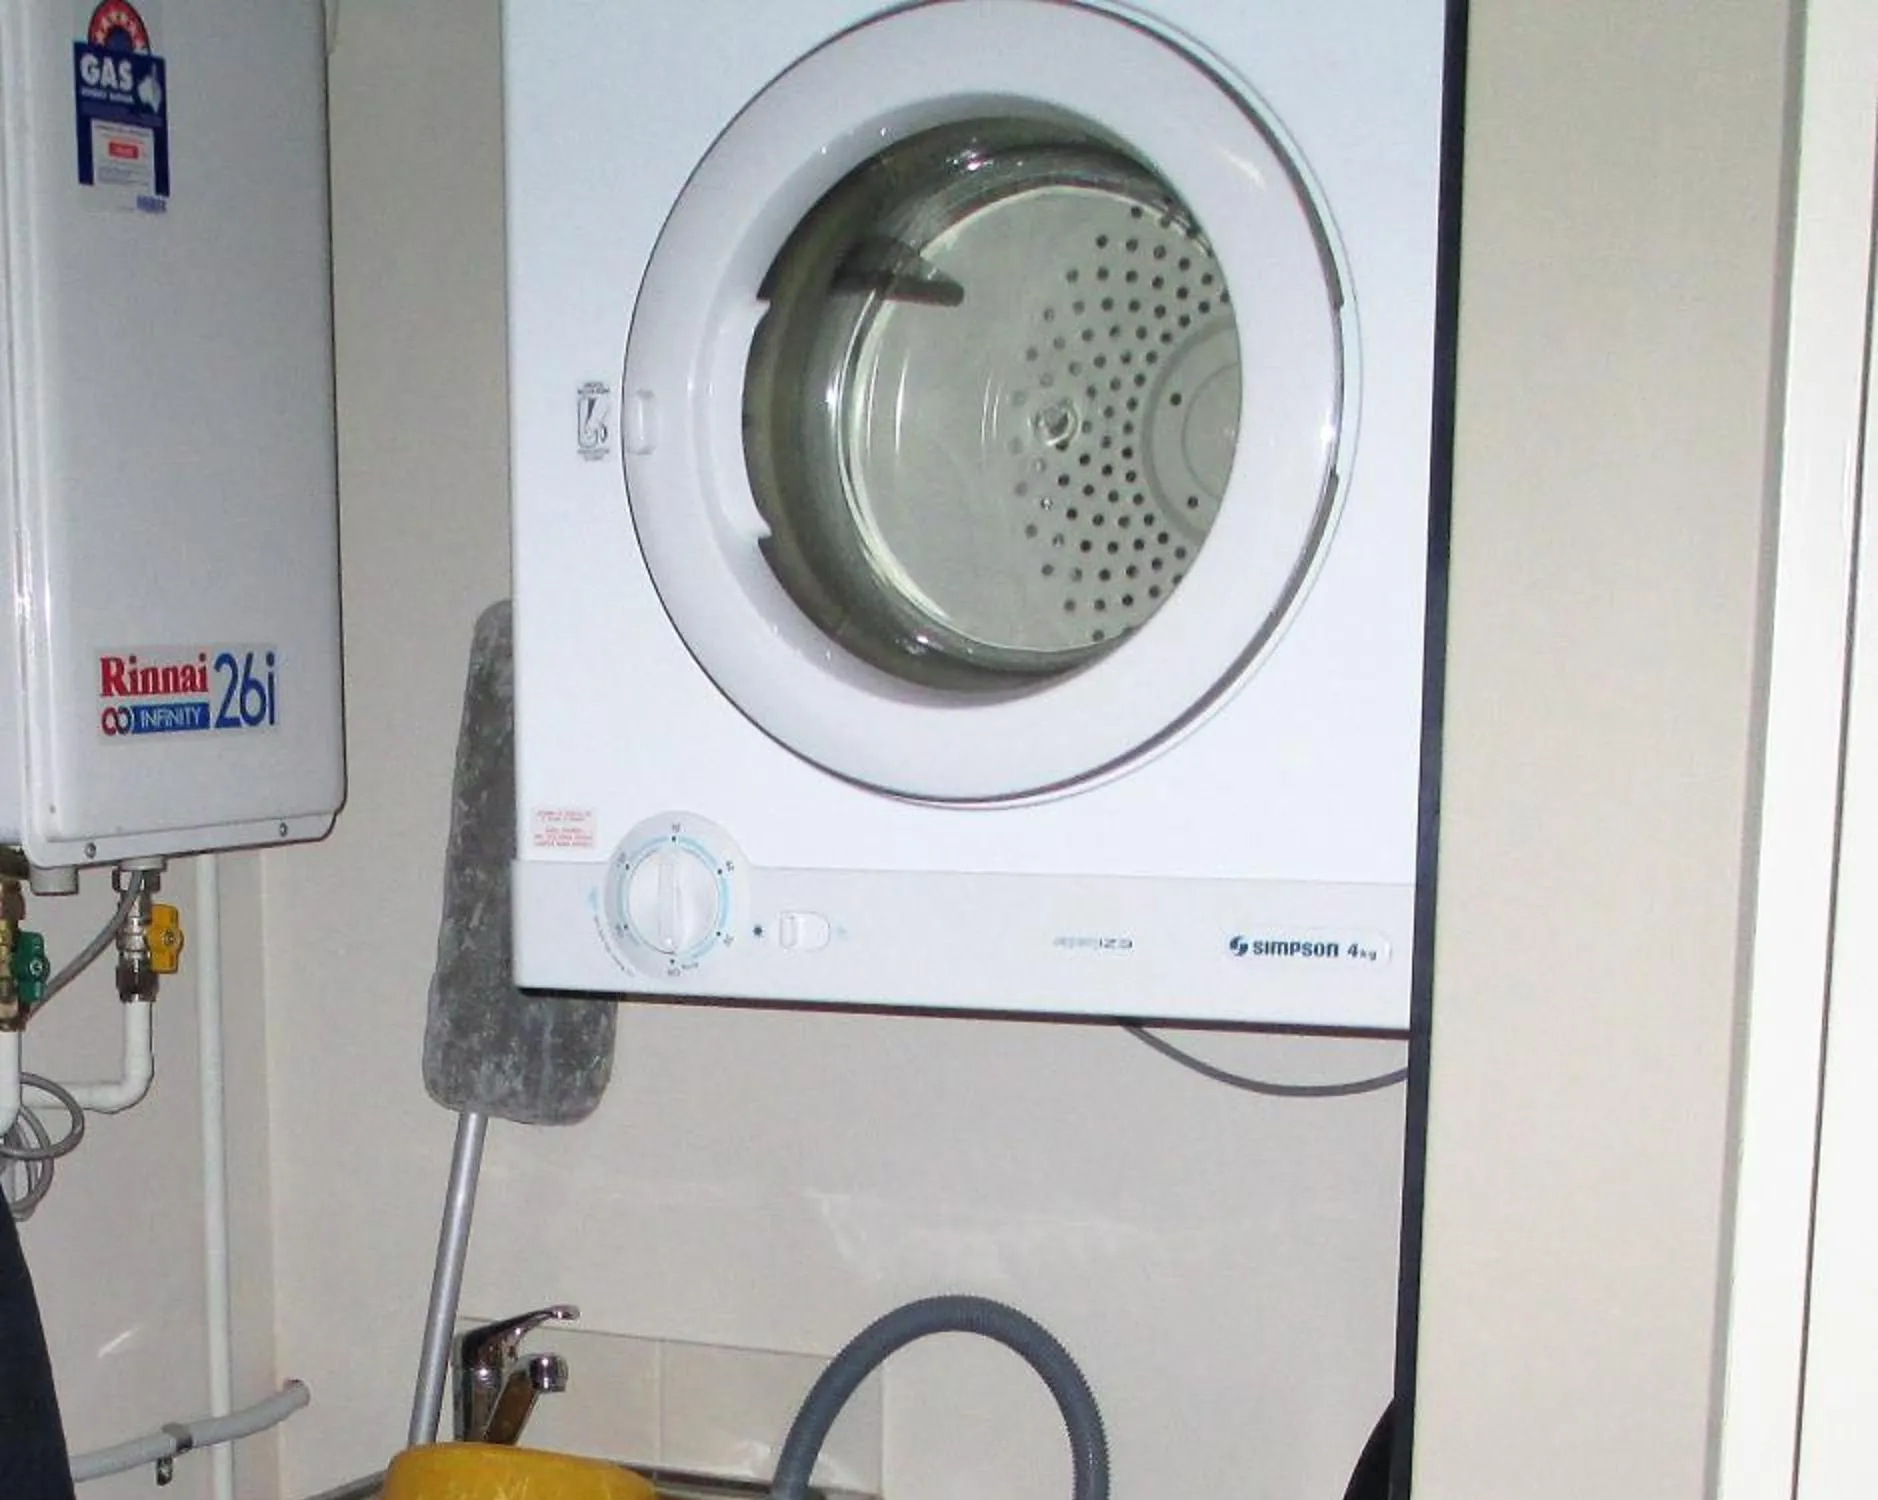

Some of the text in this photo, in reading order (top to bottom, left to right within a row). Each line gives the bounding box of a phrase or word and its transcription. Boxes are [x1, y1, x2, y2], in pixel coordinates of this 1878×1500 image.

[80, 54, 134, 91] GAS
[100, 652, 275, 728] Rinnai 26i
[140, 707, 201, 730] INFINITY
[1252, 940, 1340, 958] SIMPSON
